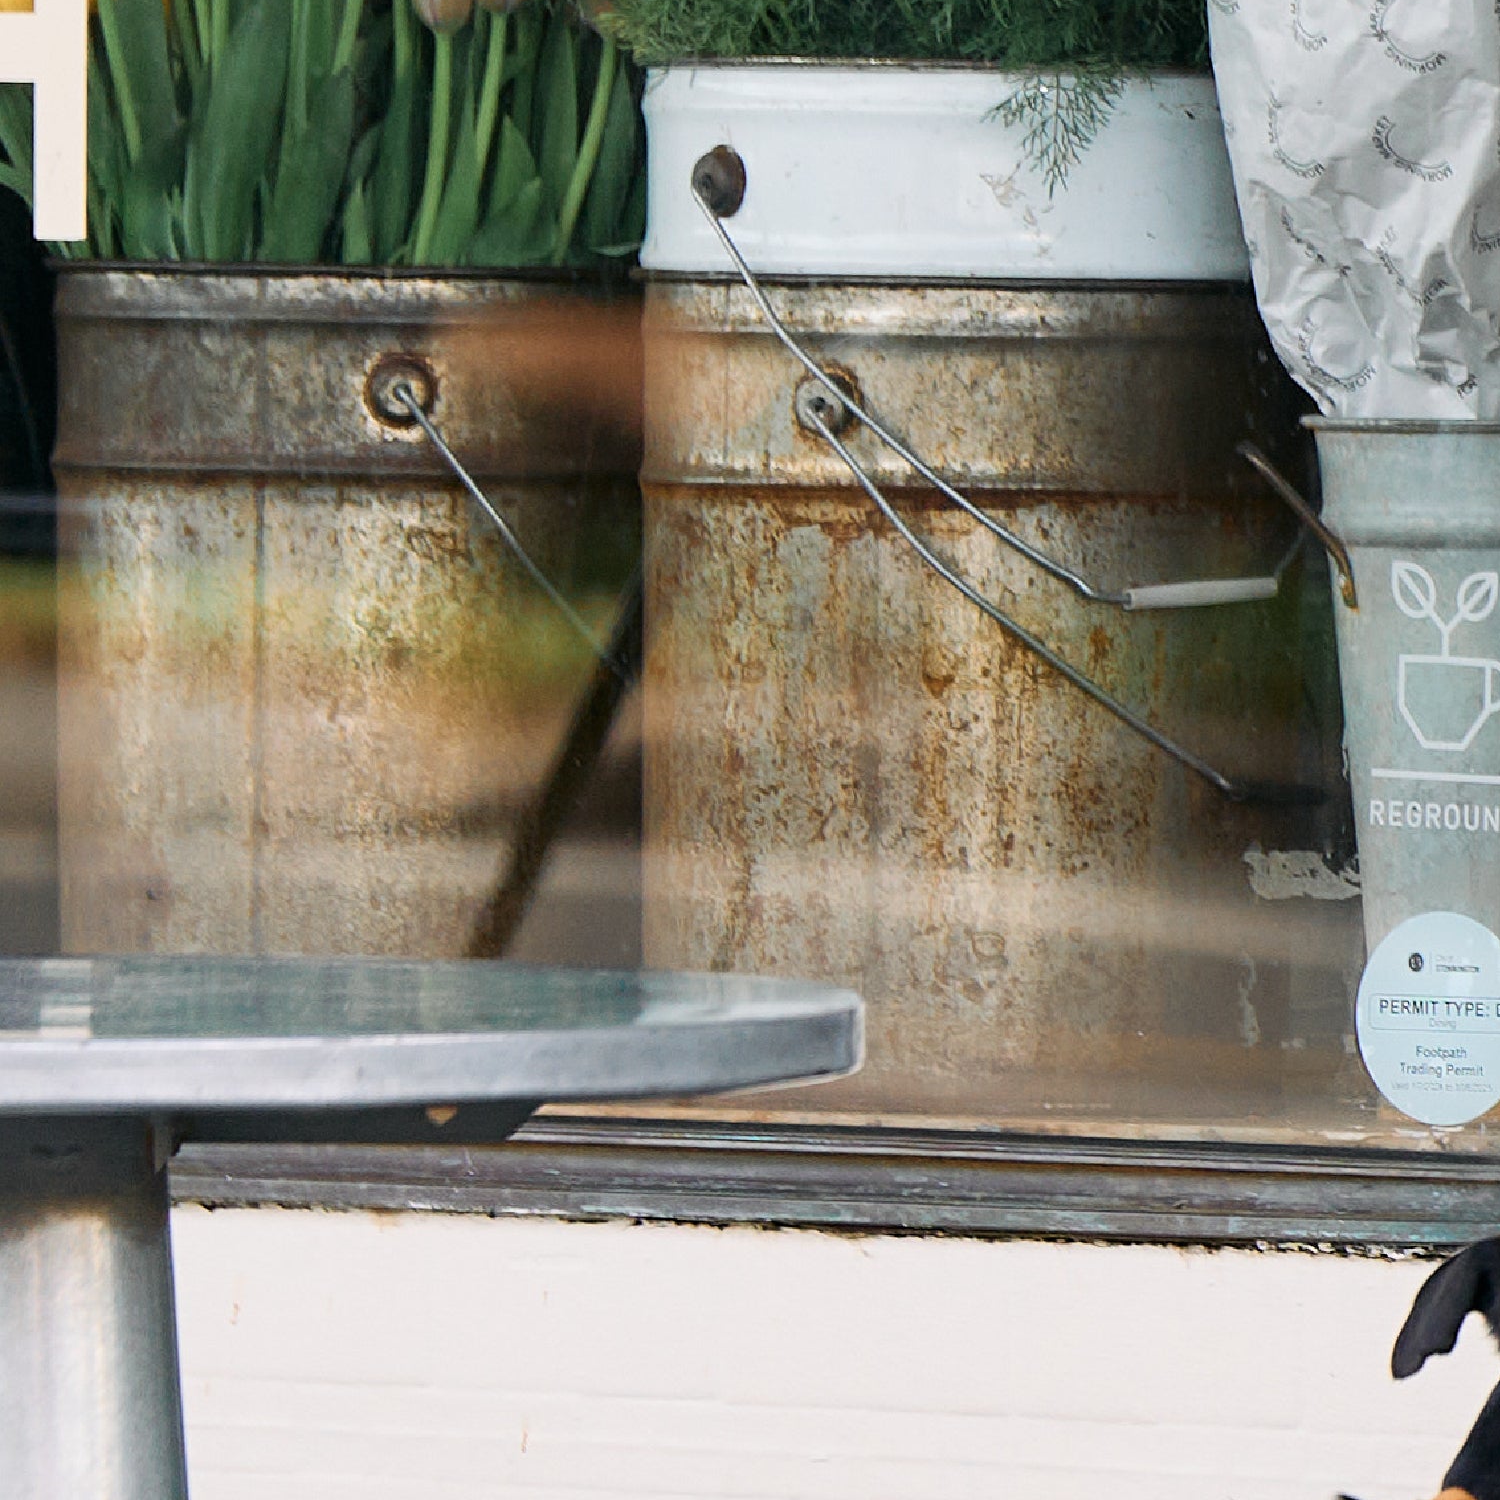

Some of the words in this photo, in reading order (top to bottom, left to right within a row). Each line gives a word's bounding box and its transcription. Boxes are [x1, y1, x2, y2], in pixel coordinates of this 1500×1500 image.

[1379, 999, 1439, 1017] PERMIT
[1444, 1001, 1490, 1017] TYPE:
[1415, 1045, 1468, 1061] Footpath
[1400, 1062, 1442, 1078] Trading
[1445, 1064, 1485, 1077] Permit
